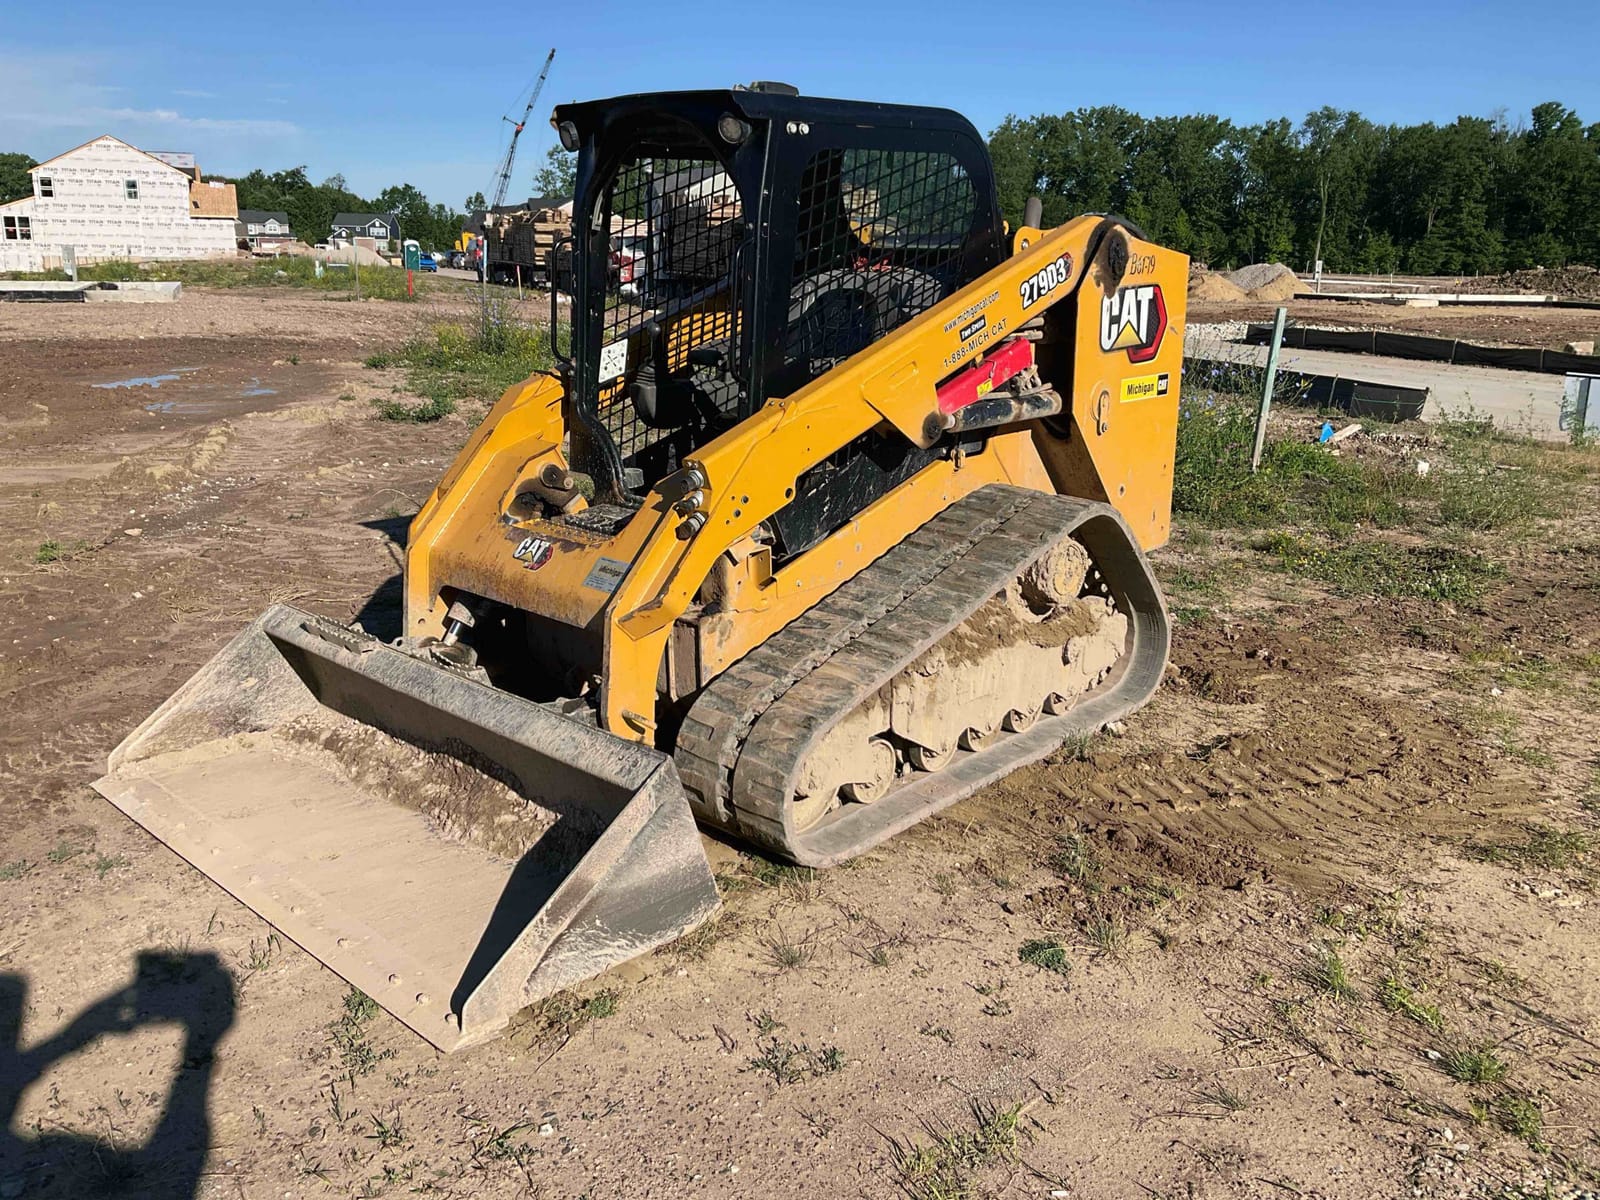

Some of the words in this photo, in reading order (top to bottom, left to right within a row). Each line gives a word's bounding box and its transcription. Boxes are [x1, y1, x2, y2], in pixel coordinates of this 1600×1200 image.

[1020, 257, 1067, 309] 279D3
[943, 290, 1000, 333] www.michigancat.com
[1100, 286, 1154, 351] CAT
[943, 330, 990, 368] 1-888-MICH
[991, 318, 1007, 336] CAT
[1127, 382, 1155, 396] Michigan
[514, 537, 551, 562] CAT
